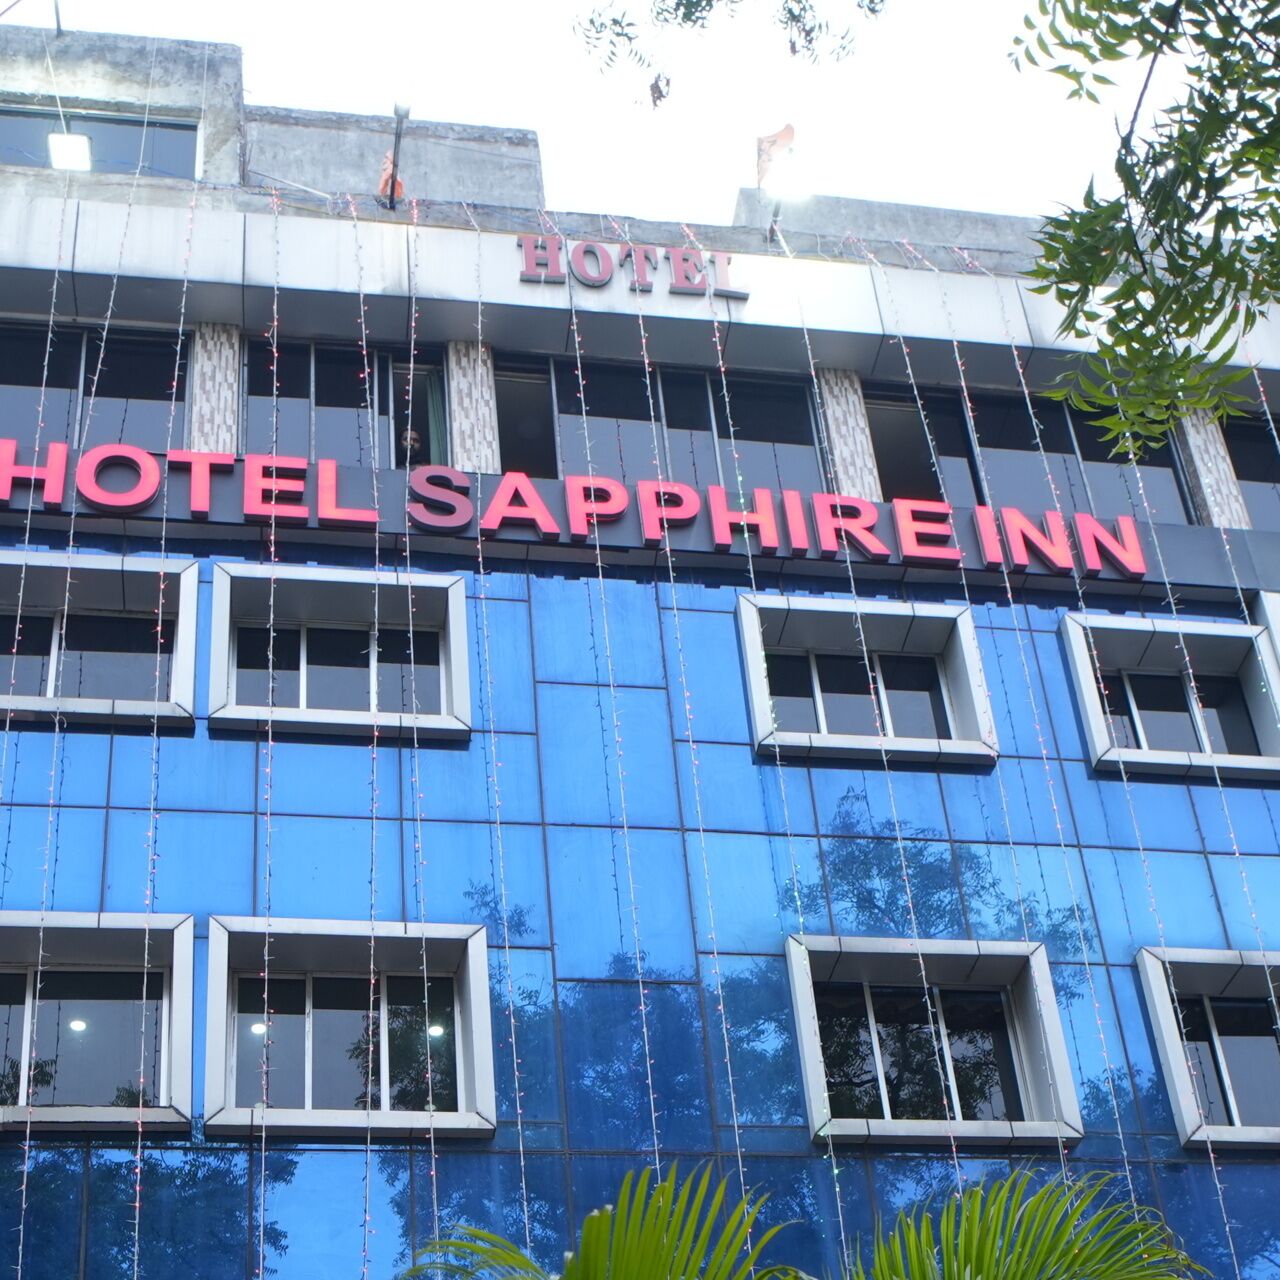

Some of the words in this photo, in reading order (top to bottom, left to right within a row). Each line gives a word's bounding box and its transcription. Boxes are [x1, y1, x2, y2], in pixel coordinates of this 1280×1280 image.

[516, 235, 750, 300] HOTEL
[408, 464, 962, 570] SAPPHIRE
[972, 504, 1147, 581] INN
